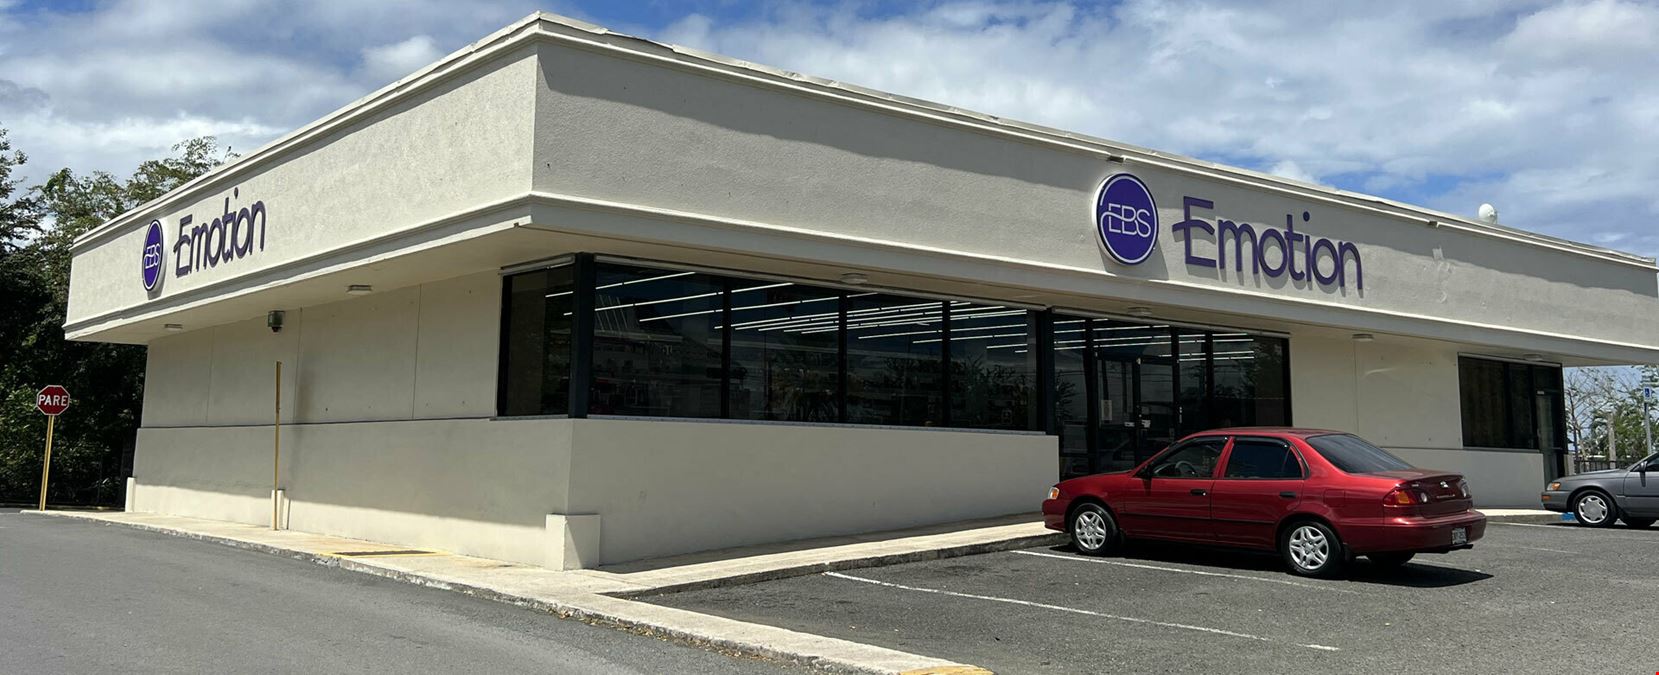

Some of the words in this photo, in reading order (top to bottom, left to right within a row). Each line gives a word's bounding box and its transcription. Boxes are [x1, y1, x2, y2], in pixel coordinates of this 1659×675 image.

[173, 187, 265, 277] Emotion
[1100, 202, 1151, 238] EBS
[144, 243, 160, 269] EBS
[1172, 196, 1363, 290] Emotion
[38, 394, 68, 406] PARE
